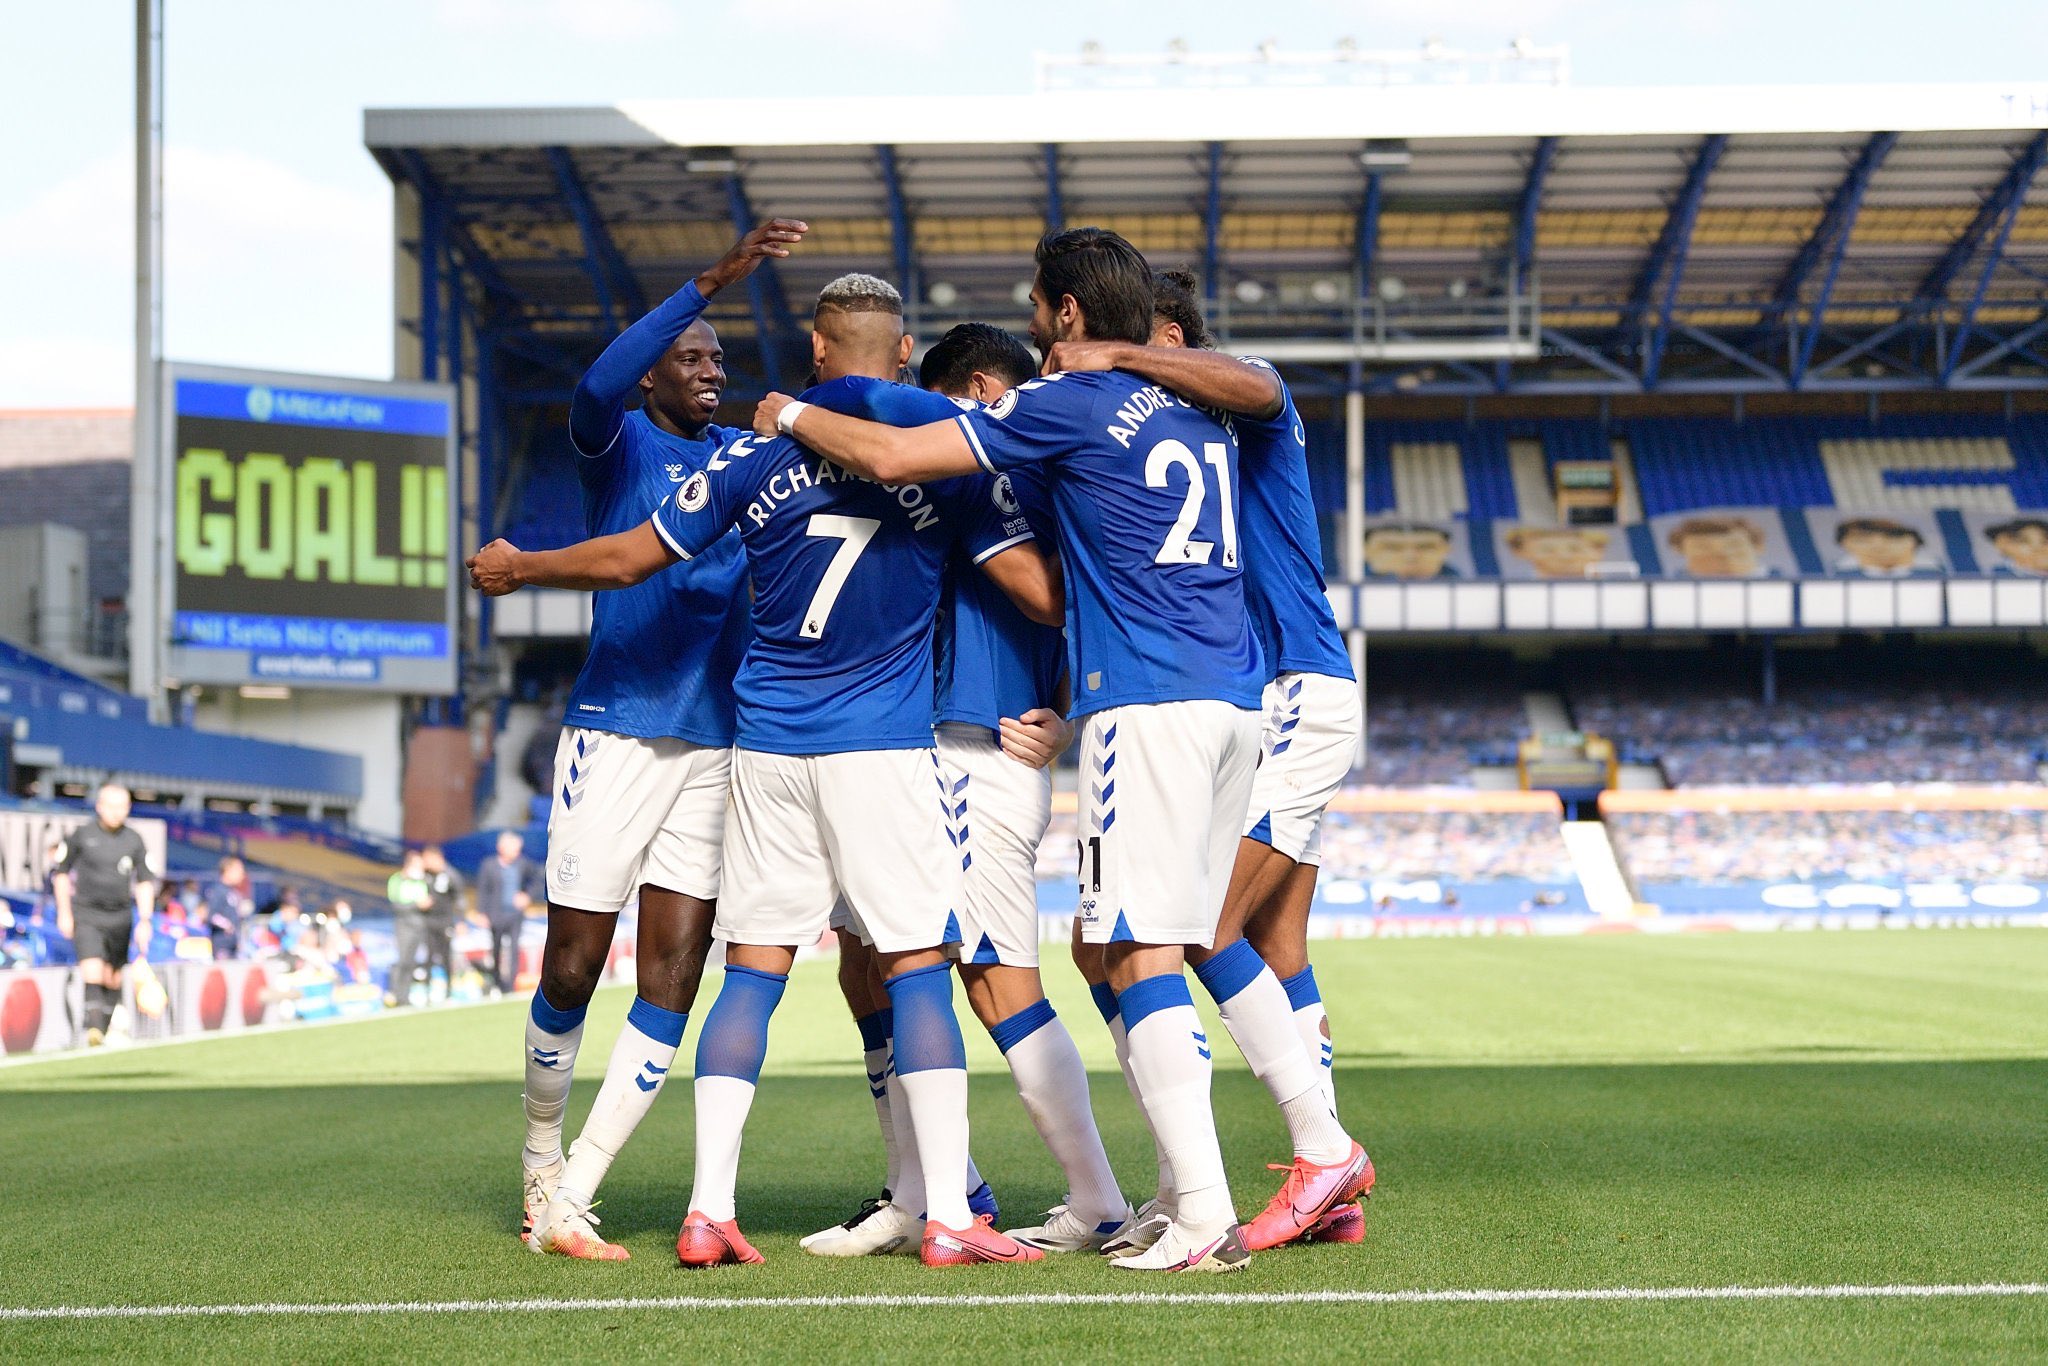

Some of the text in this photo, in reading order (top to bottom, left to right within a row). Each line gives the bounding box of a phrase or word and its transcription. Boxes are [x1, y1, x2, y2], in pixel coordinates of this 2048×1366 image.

[1106, 385, 1174, 449] ANDRE
[175, 448, 447, 588] GOAL!!
[746, 458, 940, 532] RICHAON
[1144, 438, 1239, 569] 21
[799, 513, 882, 640] 7
[191, 616, 225, 643] Nil
[330, 623, 435, 655] Optimum
